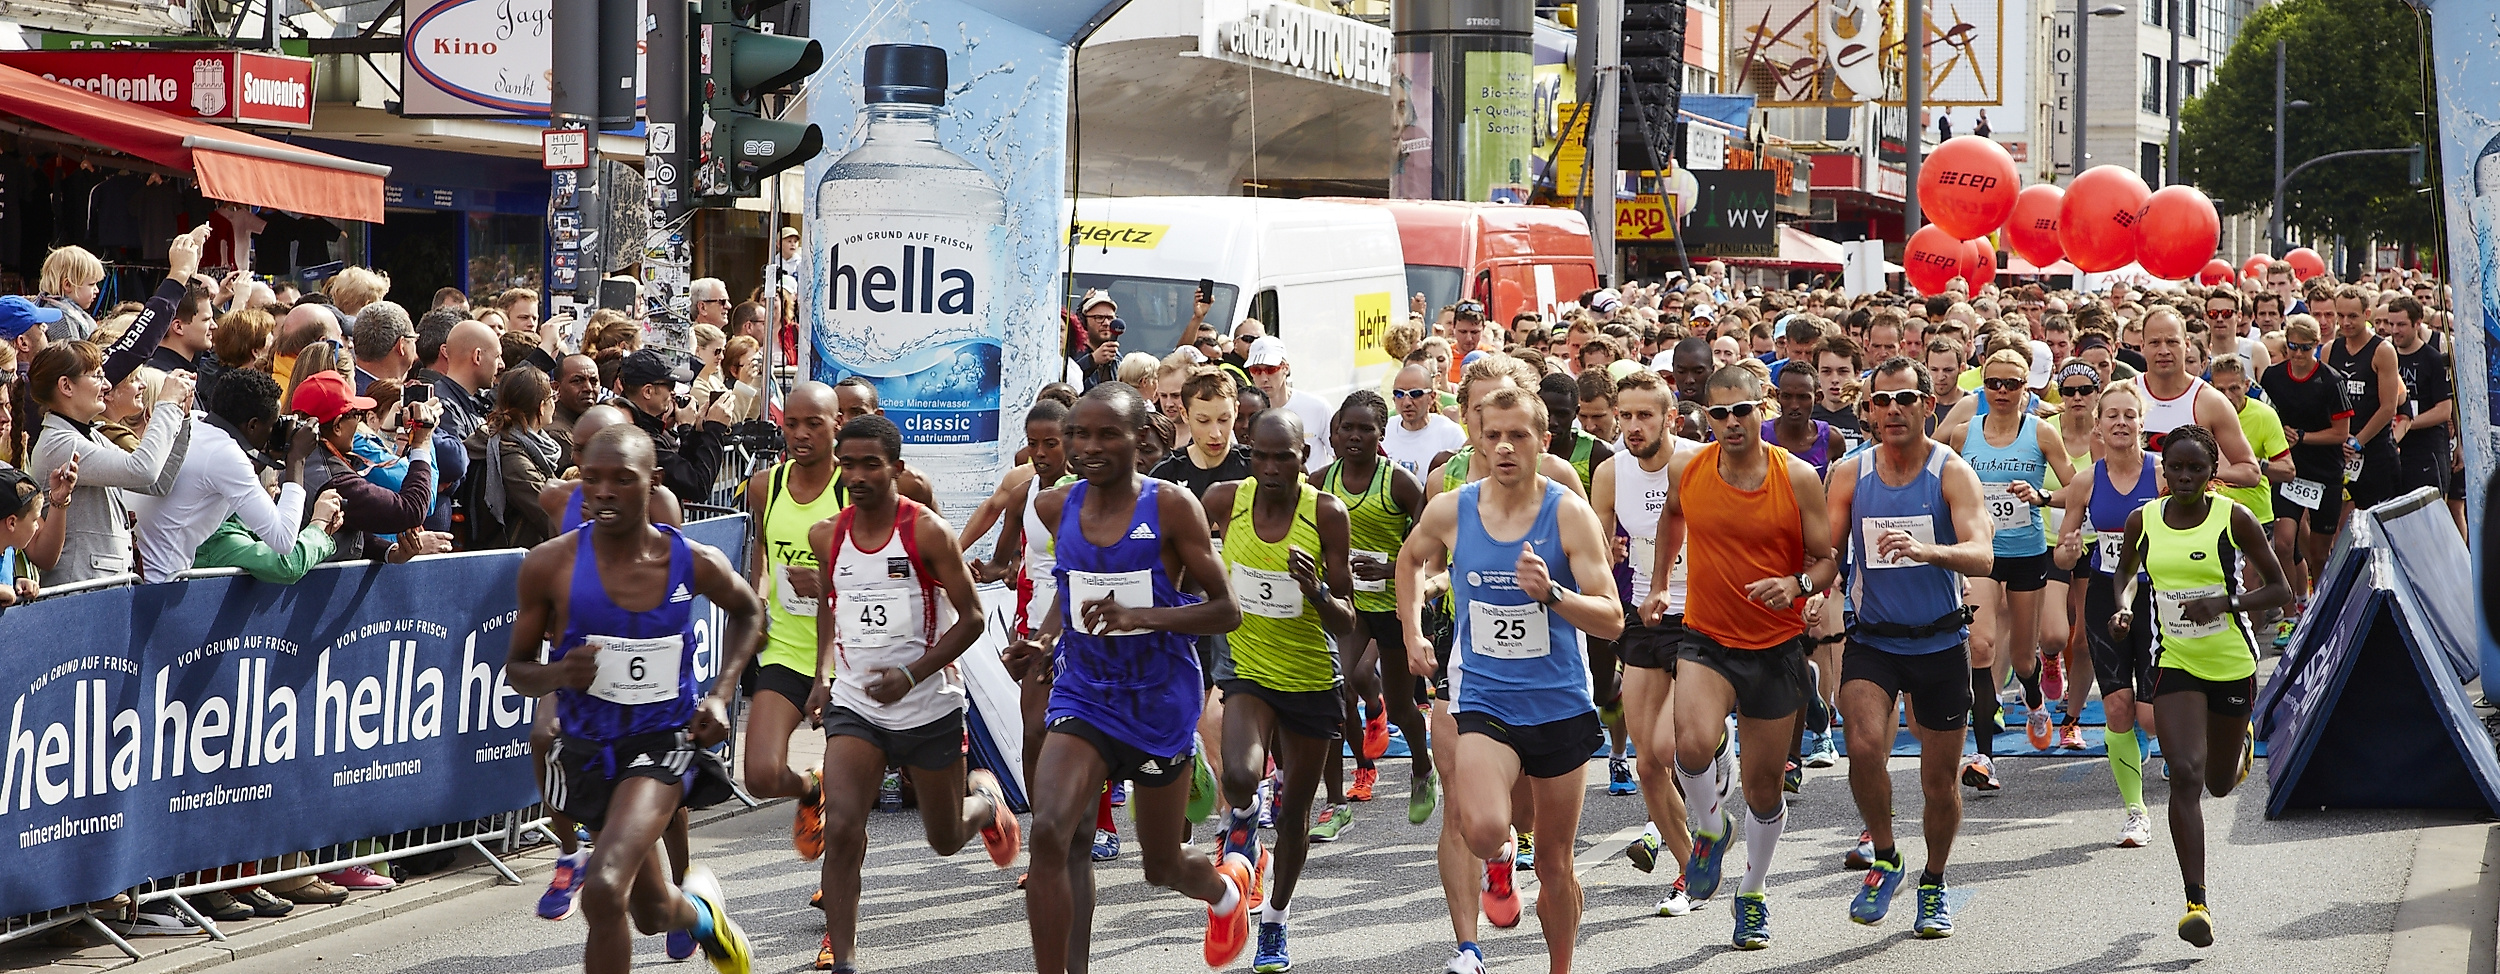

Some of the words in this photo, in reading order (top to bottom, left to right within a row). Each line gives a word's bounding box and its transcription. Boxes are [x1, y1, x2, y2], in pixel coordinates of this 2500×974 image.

[496, 0, 552, 40] Jag
[1466, 16, 1501, 26] STRÖER
[433, 38, 498, 55] Kino
[243, 71, 306, 109] Souvenirs
[494, 67, 536, 97] Sankt
[2057, 24, 2071, 135] HOTEL
[1958, 173, 1997, 192] cep
[845, 232, 864, 245] VON
[867, 230, 903, 241] GRUND
[908, 231, 930, 242] AUF
[934, 234, 974, 252] FRISCH
[1079, 225, 1153, 243] Hertz
[1925, 253, 1956, 269] cep
[828, 242, 975, 316] hella
[1358, 308, 1387, 350] Hertz
[906, 398, 970, 409] Mineralwasser
[905, 414, 971, 432] classic
[913, 433, 970, 443] natriumarm
[2287, 482, 2319, 501] 5563
[1992, 501, 2014, 518] 39
[1875, 520, 1895, 529] hella
[1259, 582, 1272, 600] 3
[1482, 576, 1511, 584] SPORT
[2166, 591, 2186, 601] hella
[482, 614, 503, 634] VON
[860, 605, 887, 627] 43
[336, 630, 357, 649] VON
[360, 620, 392, 638] GRUND
[394, 619, 414, 632] AUF
[416, 620, 448, 640] FRISCH
[1494, 619, 1526, 640] 25
[177, 647, 201, 668] VON
[205, 636, 240, 657] GRUND
[243, 635, 263, 649] AUF
[265, 636, 299, 656] FRISCH
[30, 672, 48, 695] VON
[50, 658, 80, 681] GRUND
[81, 655, 100, 670] AUF
[104, 655, 139, 677] FRISCH
[630, 656, 646, 681] 6
[314, 639, 444, 757] hella
[151, 657, 298, 782] hella
[0, 679, 142, 816] hella
[333, 758, 421, 788] mineralbrunnen
[169, 783, 273, 814] mineralbrunnen
[19, 812, 124, 849] mineralbrunnen
